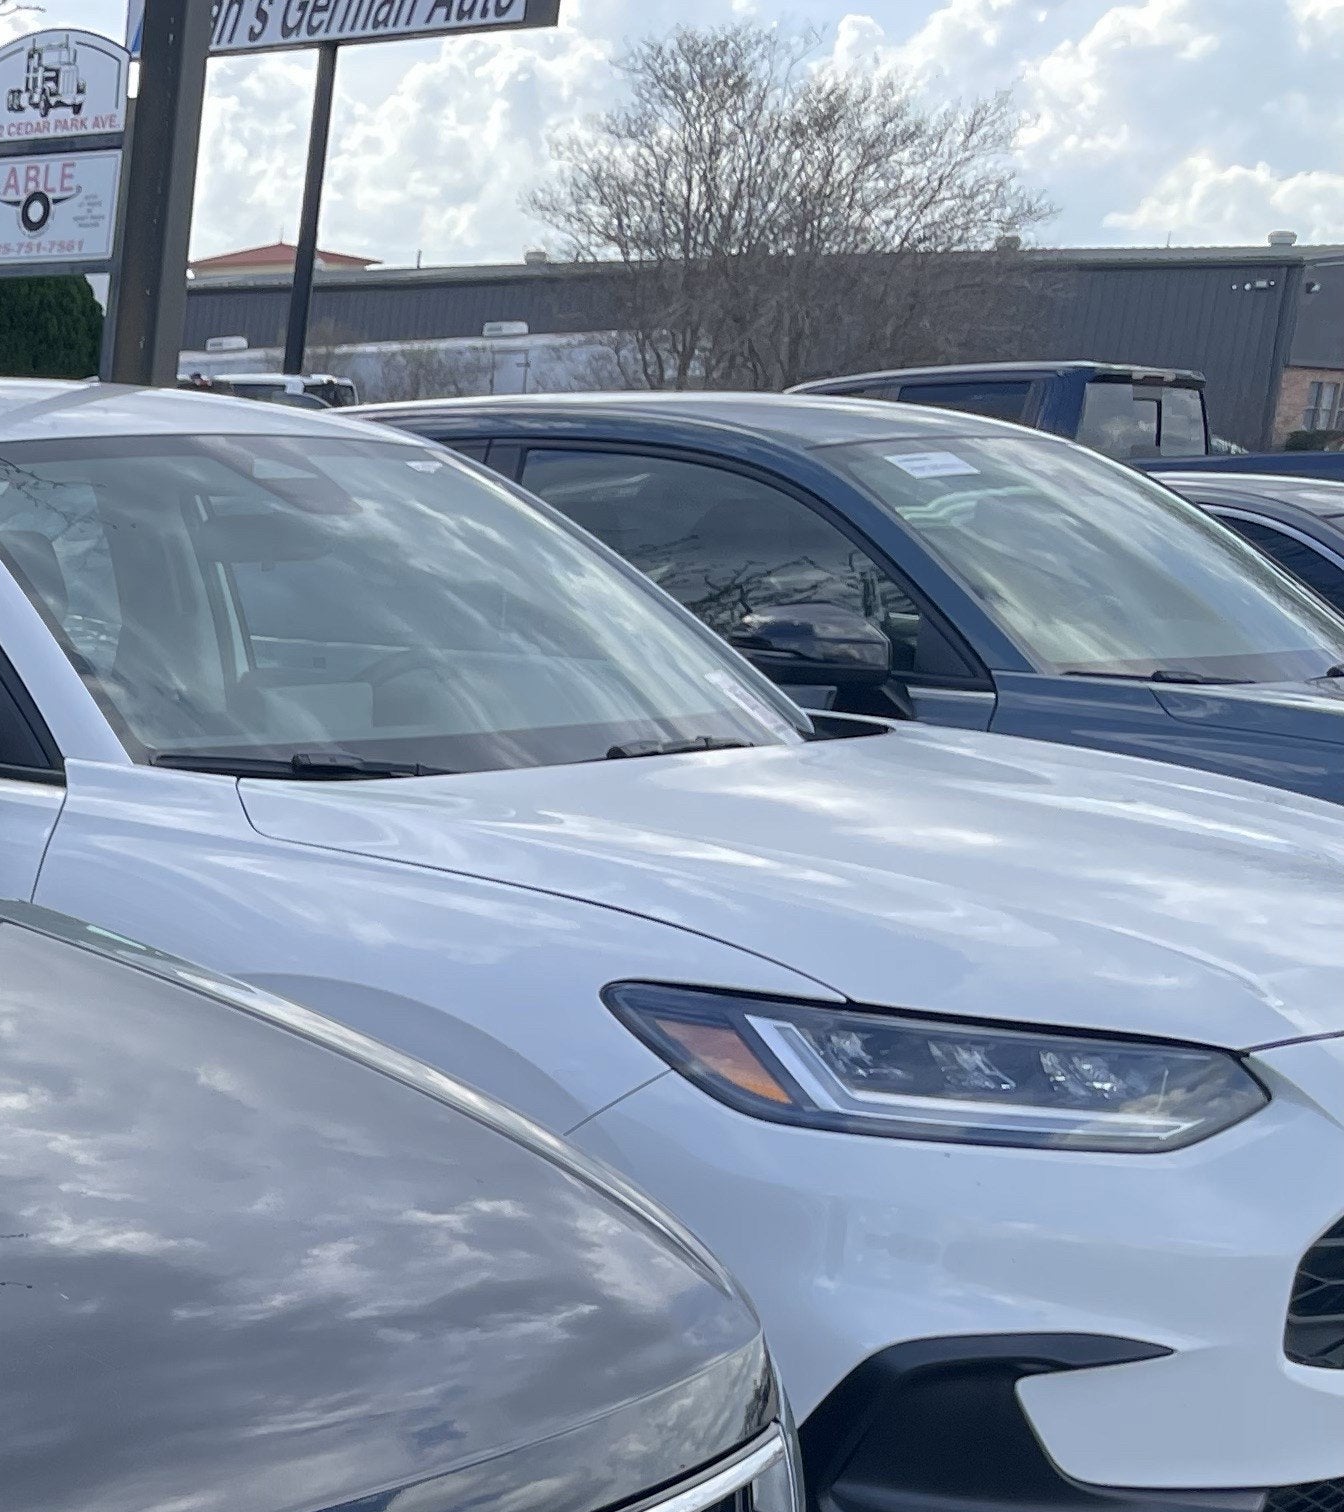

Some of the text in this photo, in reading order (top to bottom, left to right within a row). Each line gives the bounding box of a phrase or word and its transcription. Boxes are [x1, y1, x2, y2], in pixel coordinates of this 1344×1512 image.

[7, 119, 51, 137] CEDAR
[53, 116, 88, 133] PARK
[2, 161, 76, 196] ABLE
